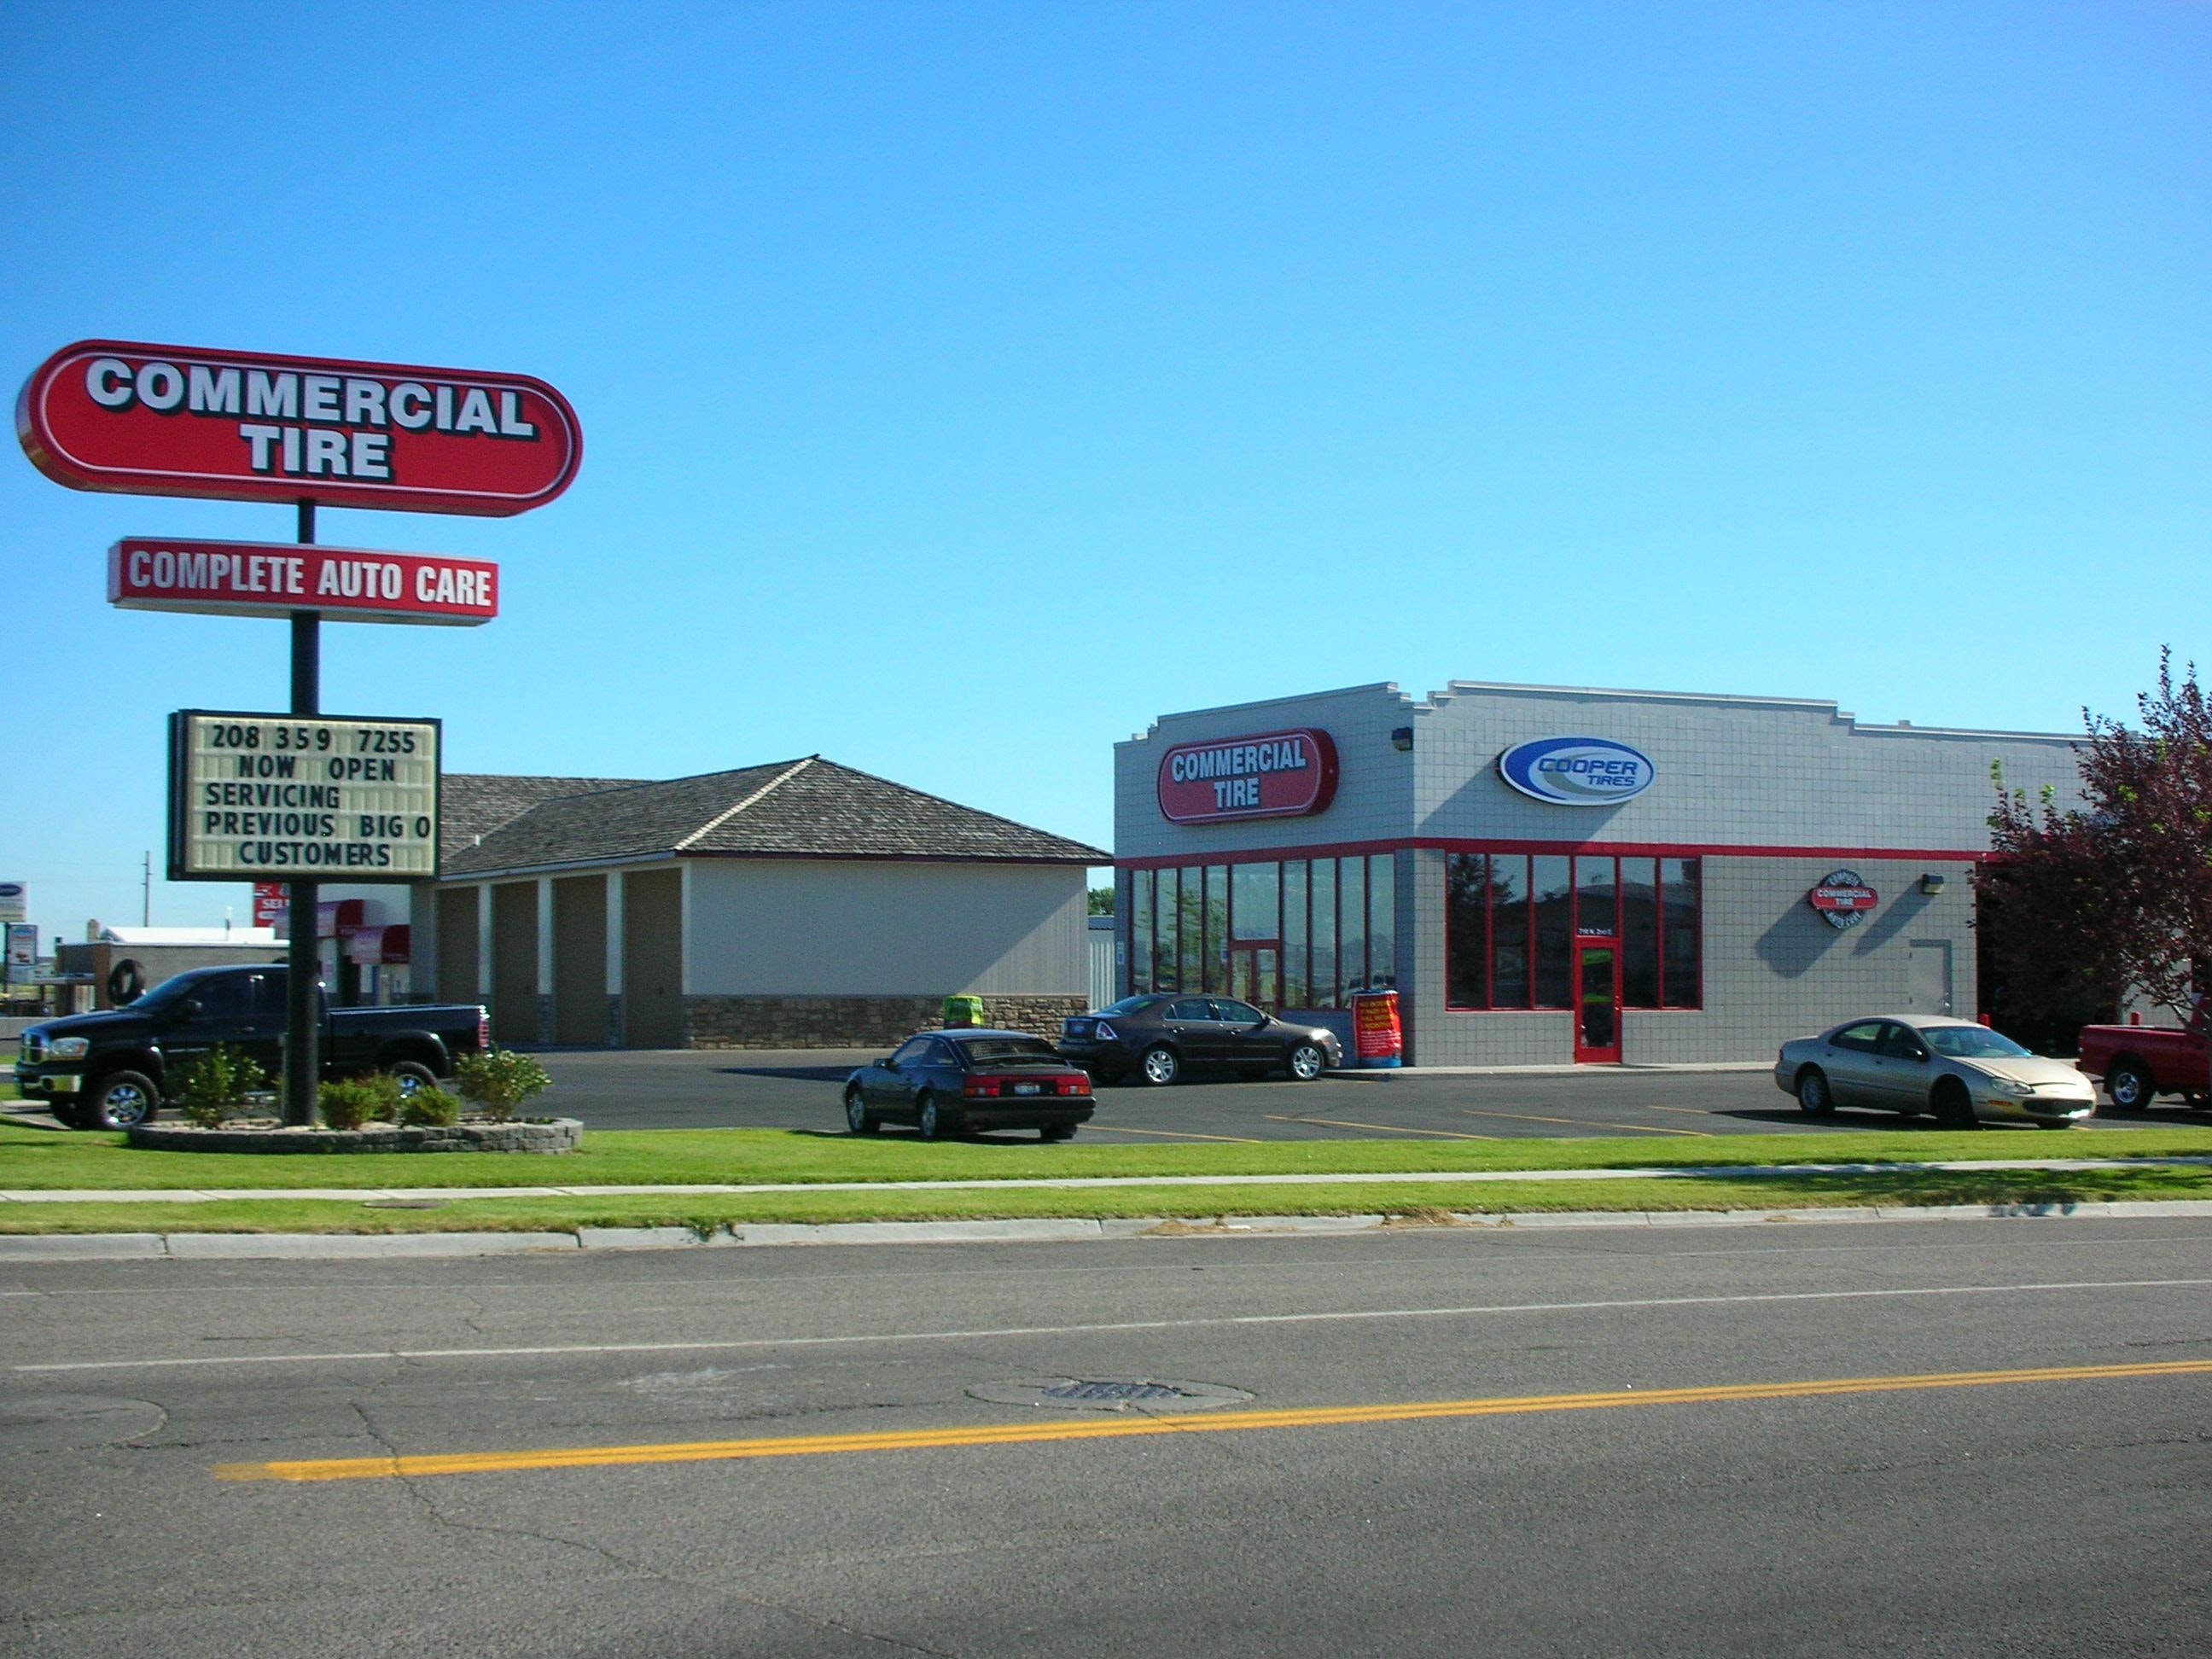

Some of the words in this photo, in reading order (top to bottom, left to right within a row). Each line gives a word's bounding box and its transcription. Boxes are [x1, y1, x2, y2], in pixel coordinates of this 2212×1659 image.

[85, 358, 535, 437] COMMERCIAL
[239, 424, 390, 479] TIRE
[130, 550, 305, 594] COMPLETE
[317, 560, 403, 600] AUTO
[416, 566, 492, 607] CARE
[212, 725, 259, 748] 208
[276, 726, 331, 751] 359
[358, 730, 416, 754] 7255
[239, 754, 296, 778] NOW
[329, 757, 395, 781] OPEN
[1171, 740, 1307, 783] COMMERCIAL
[1537, 758, 1639, 775] COOPER
[1213, 777, 1260, 809] TIRE
[1586, 775, 1637, 787] TIRES
[206, 783, 341, 809] SERVICING
[206, 812, 335, 836] PREVIOUS
[360, 815, 404, 838] BIG
[239, 841, 391, 866] CUSTOMERS
